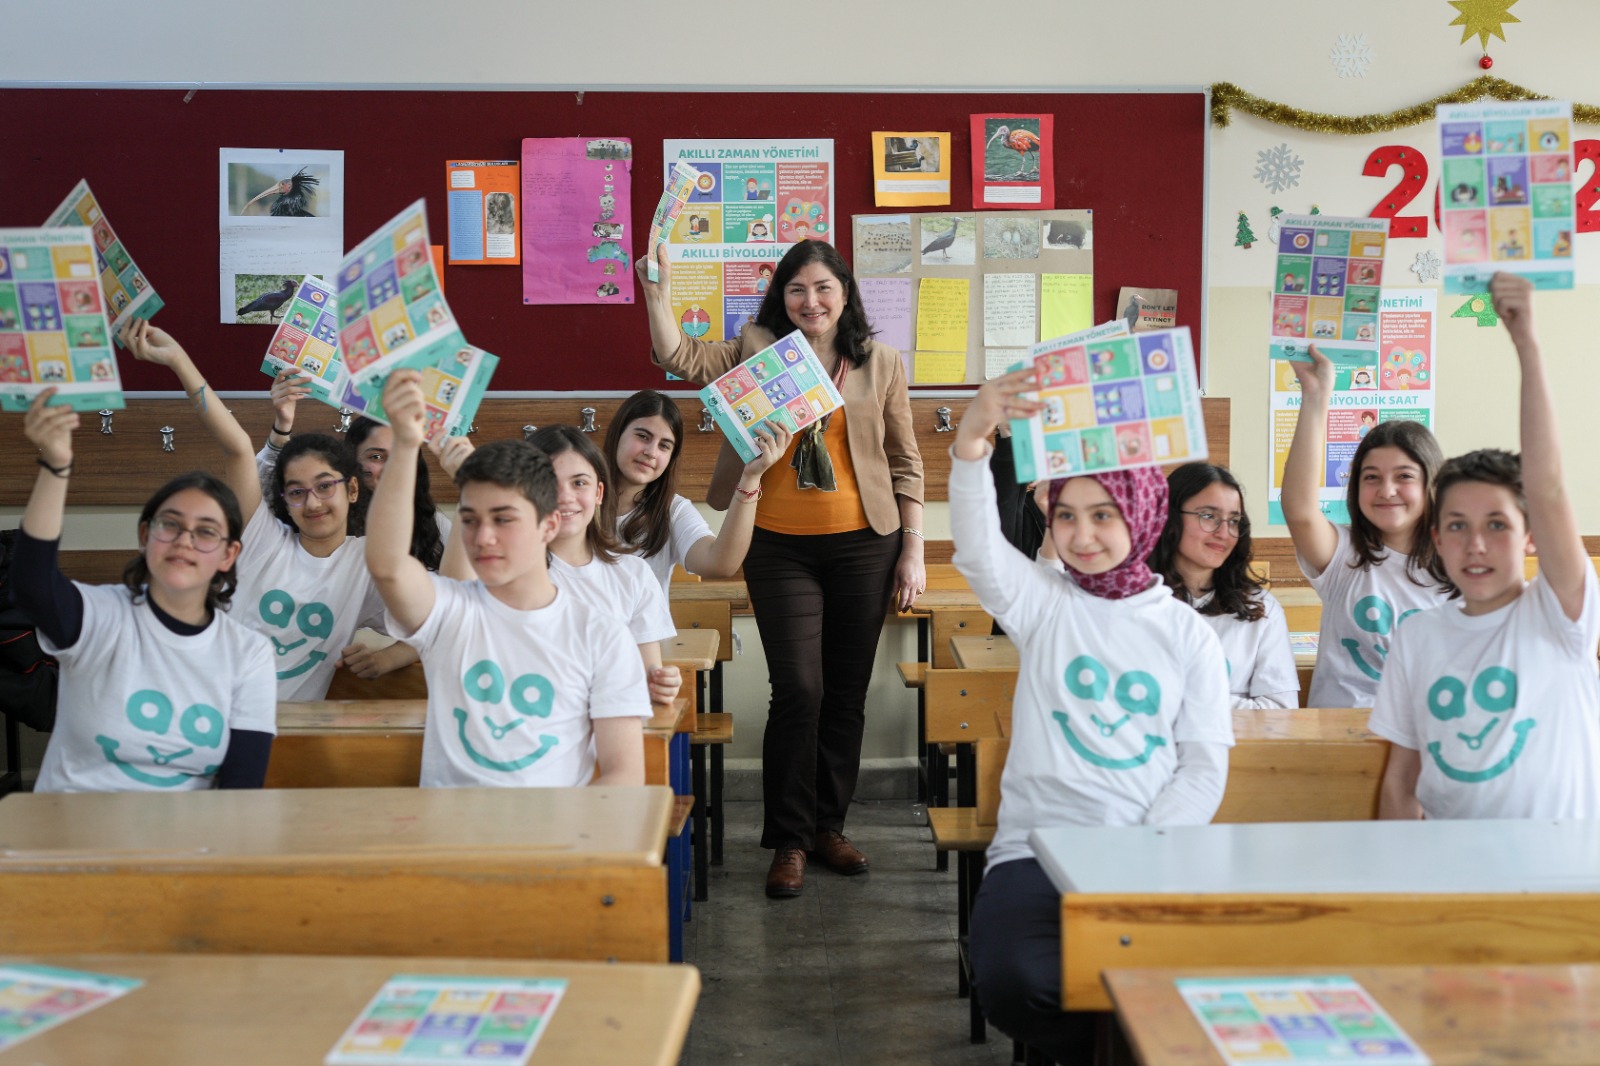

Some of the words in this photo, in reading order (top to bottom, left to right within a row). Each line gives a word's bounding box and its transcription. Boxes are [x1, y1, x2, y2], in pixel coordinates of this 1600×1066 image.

[678, 148, 715, 159] AKILLI
[717, 148, 760, 159] ZAMAN
[762, 146, 820, 158] YÖNETİMİ
[1285, 218, 1311, 226] AKILLI
[1312, 220, 1342, 228] ZAMAN
[681, 248, 719, 259] AKILLI
[722, 245, 784, 259] BİYOLOJİK
[1380, 296, 1423, 308] NETİMİ
[1388, 395, 1419, 405] SAAT
